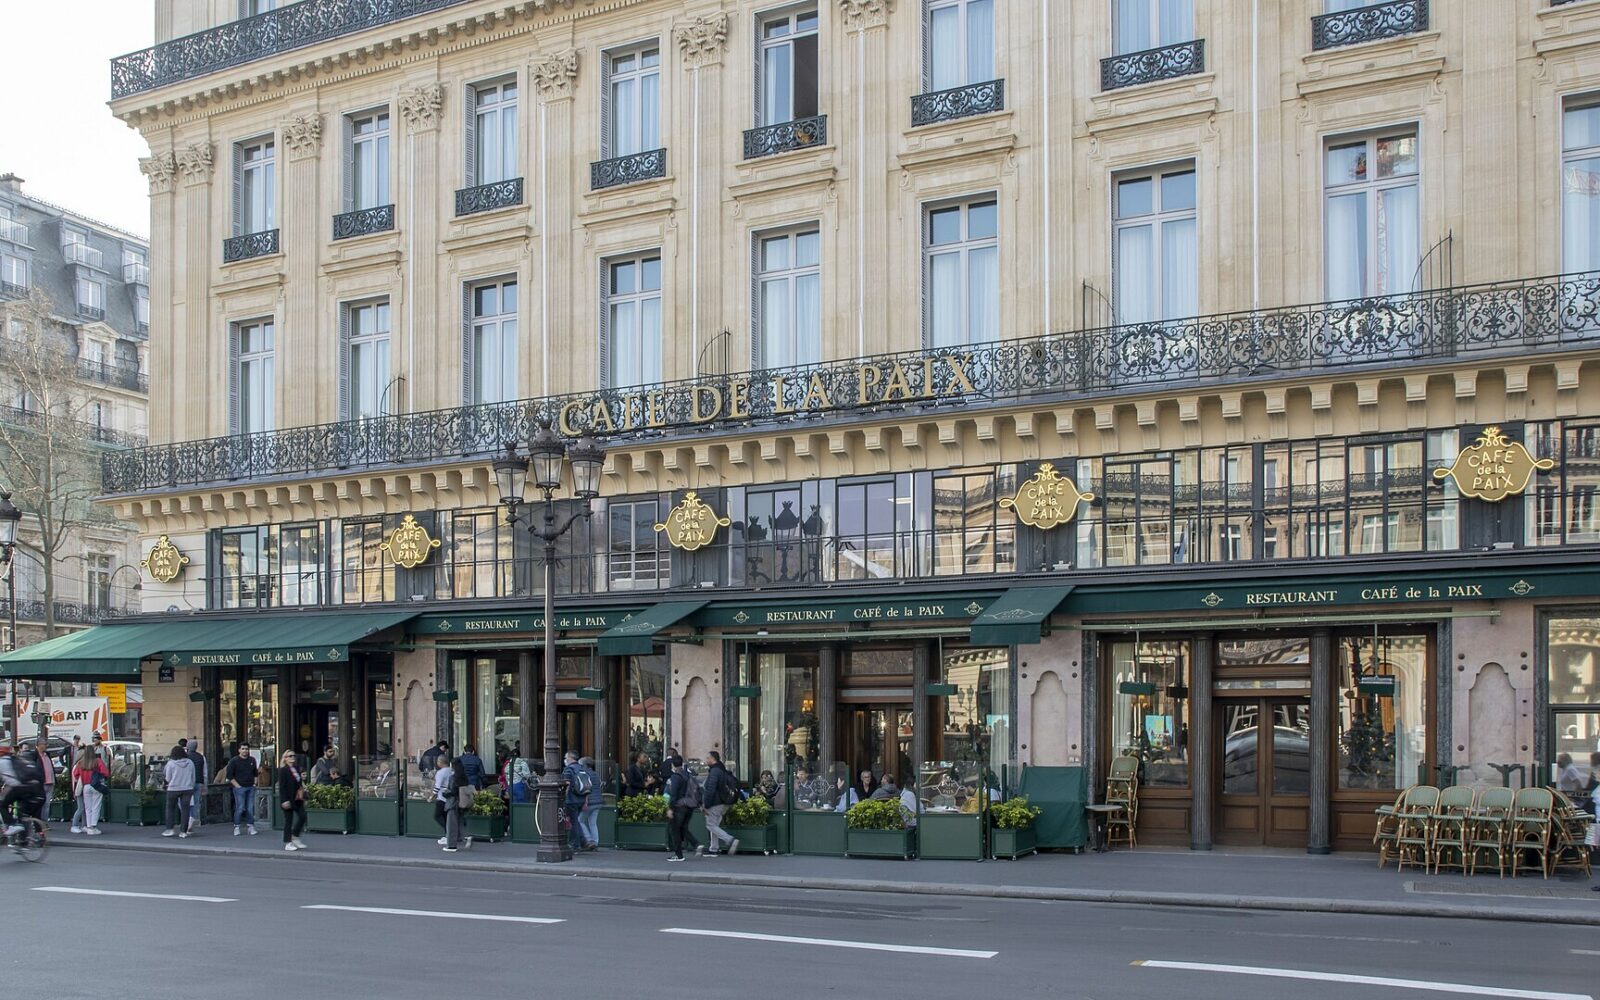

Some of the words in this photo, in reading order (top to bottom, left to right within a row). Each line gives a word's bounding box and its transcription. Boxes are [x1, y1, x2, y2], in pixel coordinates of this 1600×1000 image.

[689, 379, 751, 424] DE
[773, 373, 834, 414] LA
[857, 353, 976, 404] PAIX
[1468, 449, 1515, 468] CAFE
[1478, 466, 1491, 475] de
[1495, 464, 1505, 474] la
[1472, 474, 1514, 490] PAIX
[1027, 483, 1065, 499] CAFE
[1034, 499, 1047, 507] de
[1049, 496, 1058, 505] la
[675, 510, 706, 523] CAFE
[1030, 505, 1064, 520] PAIX
[680, 522, 691, 530] de
[692, 520, 700, 529] la
[678, 529, 705, 542] PAIX
[398, 548, 421, 561] PAIX
[154, 566, 173, 576] PAIX
[1246, 590, 1338, 605] RESTAURANT
[1361, 585, 1398, 600] CAFÉ
[1405, 586, 1422, 598] de
[1428, 586, 1440, 598] la
[1448, 584, 1483, 597] PAIX
[766, 609, 836, 622] RESTAURANT
[853, 605, 881, 619] CAFÉ
[886, 607, 899, 617] de
[904, 606, 913, 617] la
[918, 605, 945, 617] PAIX
[465, 619, 520, 630] RESTAURANT
[560, 617, 570, 627] de
[574, 617, 581, 627] la
[585, 616, 606, 626] PAIX
[192, 654, 241, 664] RESTAURANT
[252, 652, 272, 662] CAFÉ
[274, 653, 284, 662] de
[286, 652, 293, 661] la
[296, 651, 314, 661] PAIX
[66, 711, 89, 721] ART
